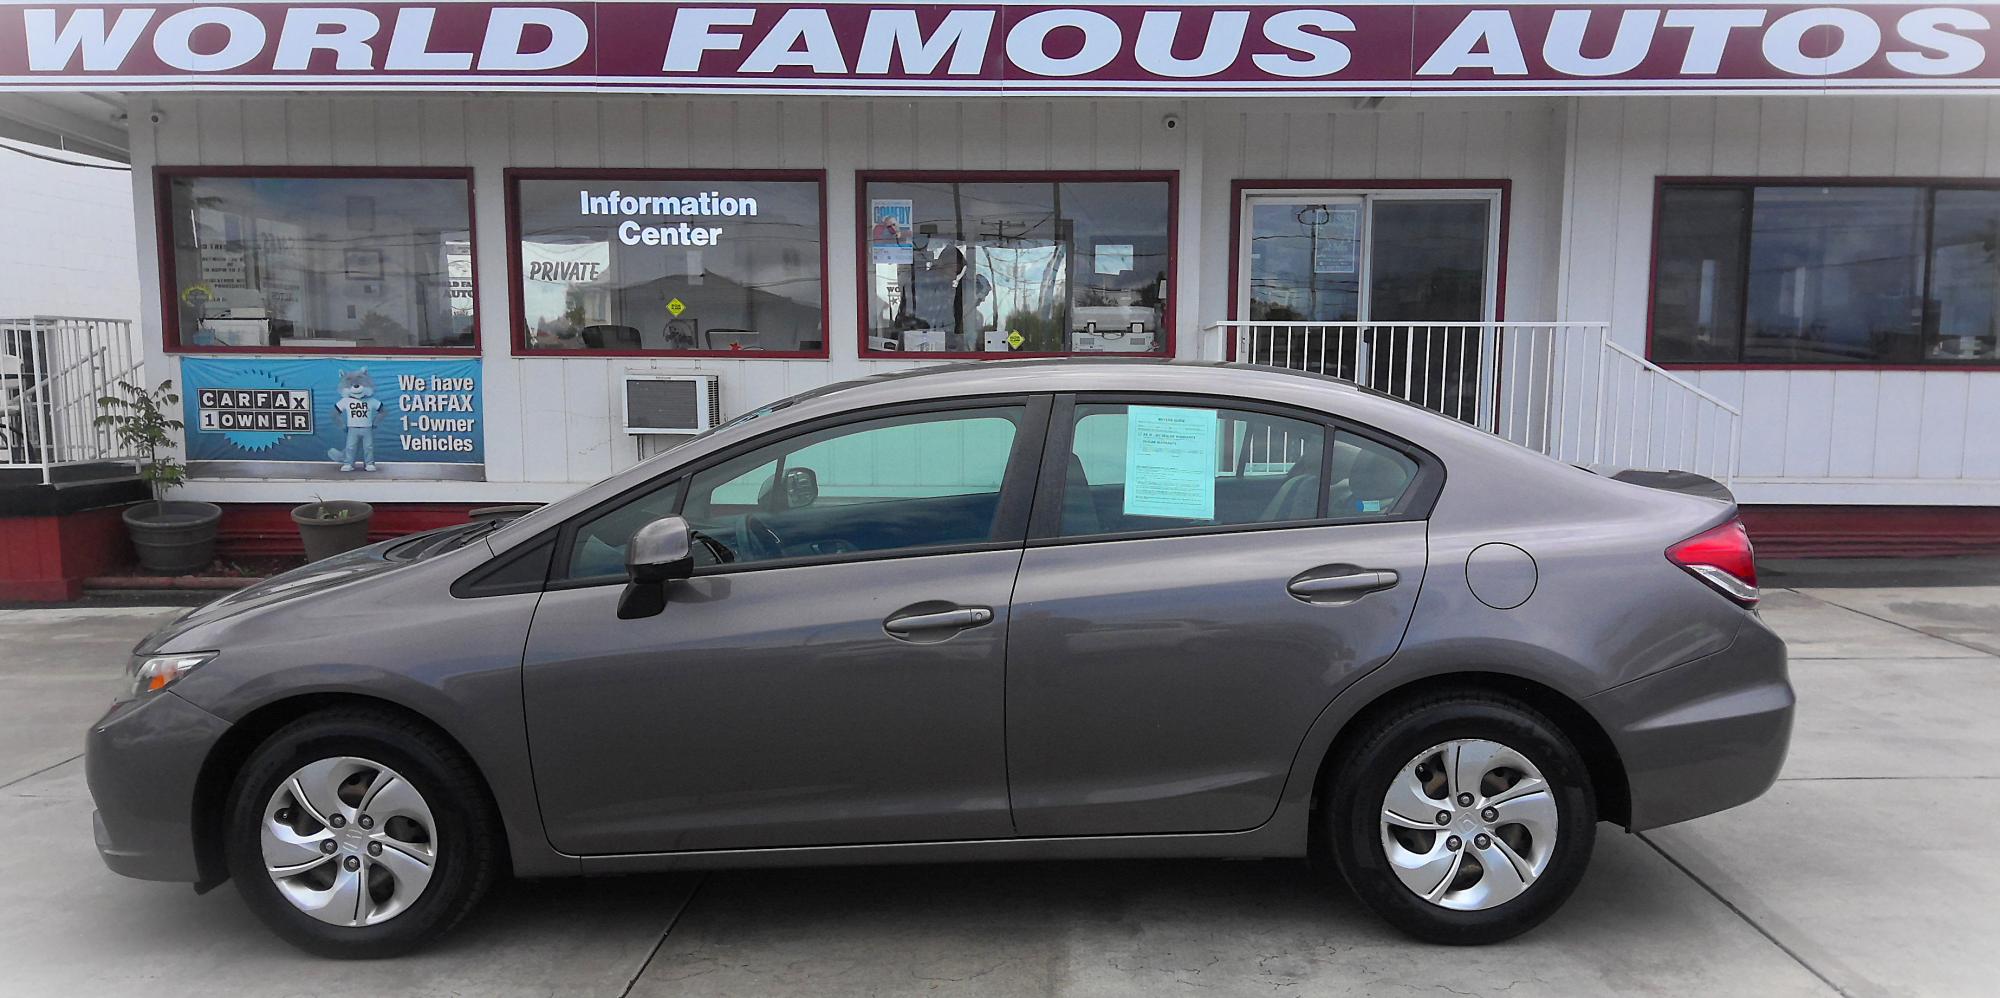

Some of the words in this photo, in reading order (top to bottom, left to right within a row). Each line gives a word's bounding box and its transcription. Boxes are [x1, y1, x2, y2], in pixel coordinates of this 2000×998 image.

[23, 7, 589, 71] WORLD
[662, 8, 1357, 77] FAMOUS
[1415, 8, 1992, 76] AUTOS
[580, 190, 758, 216] Information
[618, 220, 723, 246] Center
[529, 261, 600, 281] PRIVATE
[398, 375, 425, 391] We
[430, 375, 474, 391] have
[202, 392, 306, 410] CARFAX
[349, 402, 368, 410] CAR
[400, 394, 473, 412] CARFAX
[205, 413, 215, 427] 1
[221, 414, 307, 428] OWNER
[351, 410, 368, 418] FOX
[400, 415, 475, 432] 1-Owner
[401, 434, 473, 451] Vehicles
